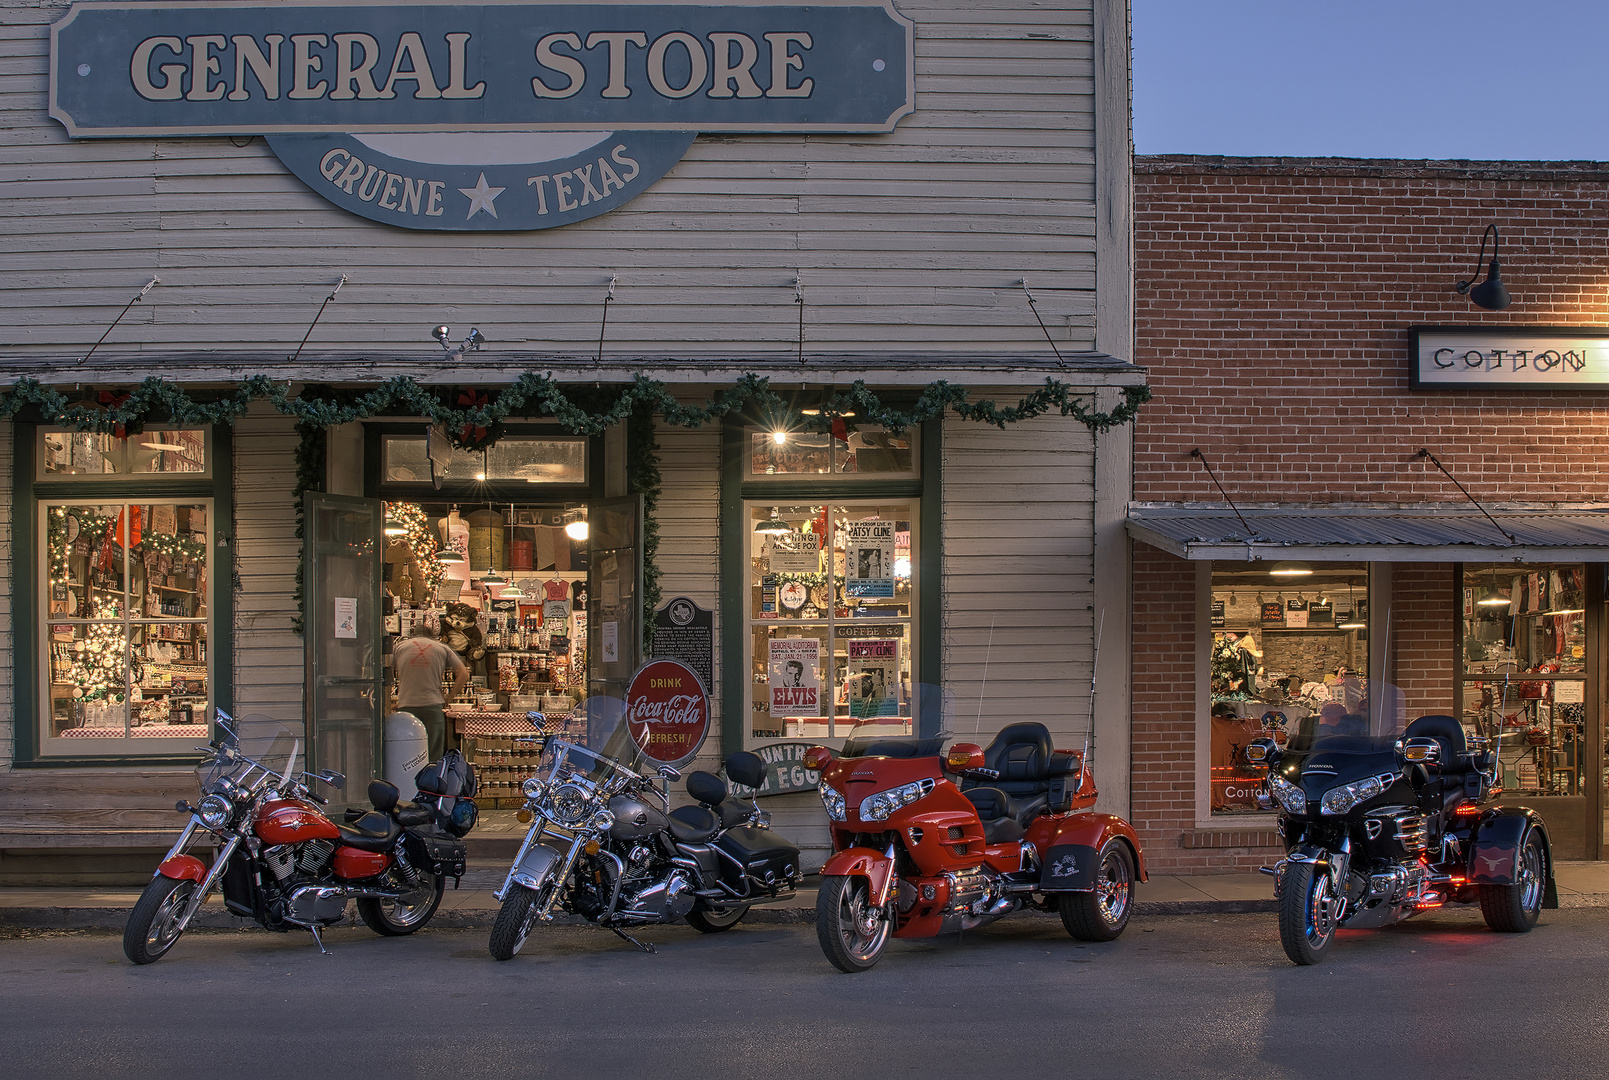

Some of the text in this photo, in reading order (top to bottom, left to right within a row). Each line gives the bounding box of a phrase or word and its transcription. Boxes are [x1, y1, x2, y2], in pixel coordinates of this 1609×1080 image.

[130, 30, 815, 102] GENERAL STORE
[319, 148, 446, 217] GRUENE
[527, 144, 640, 216] TEXAS
[1434, 348, 1586, 369] COTTON
[507, 512, 544, 524] NEW
[848, 527, 891, 536] PATSY CLINE
[838, 627, 899, 636] COFFEE 5¢
[851, 646, 894, 656] PATSY CLINE
[650, 678, 682, 688] DRINK
[773, 687, 816, 705] ELVIS
[630, 694, 702, 724] Coca-Cola
[1225, 786, 1270, 798] COTTON
